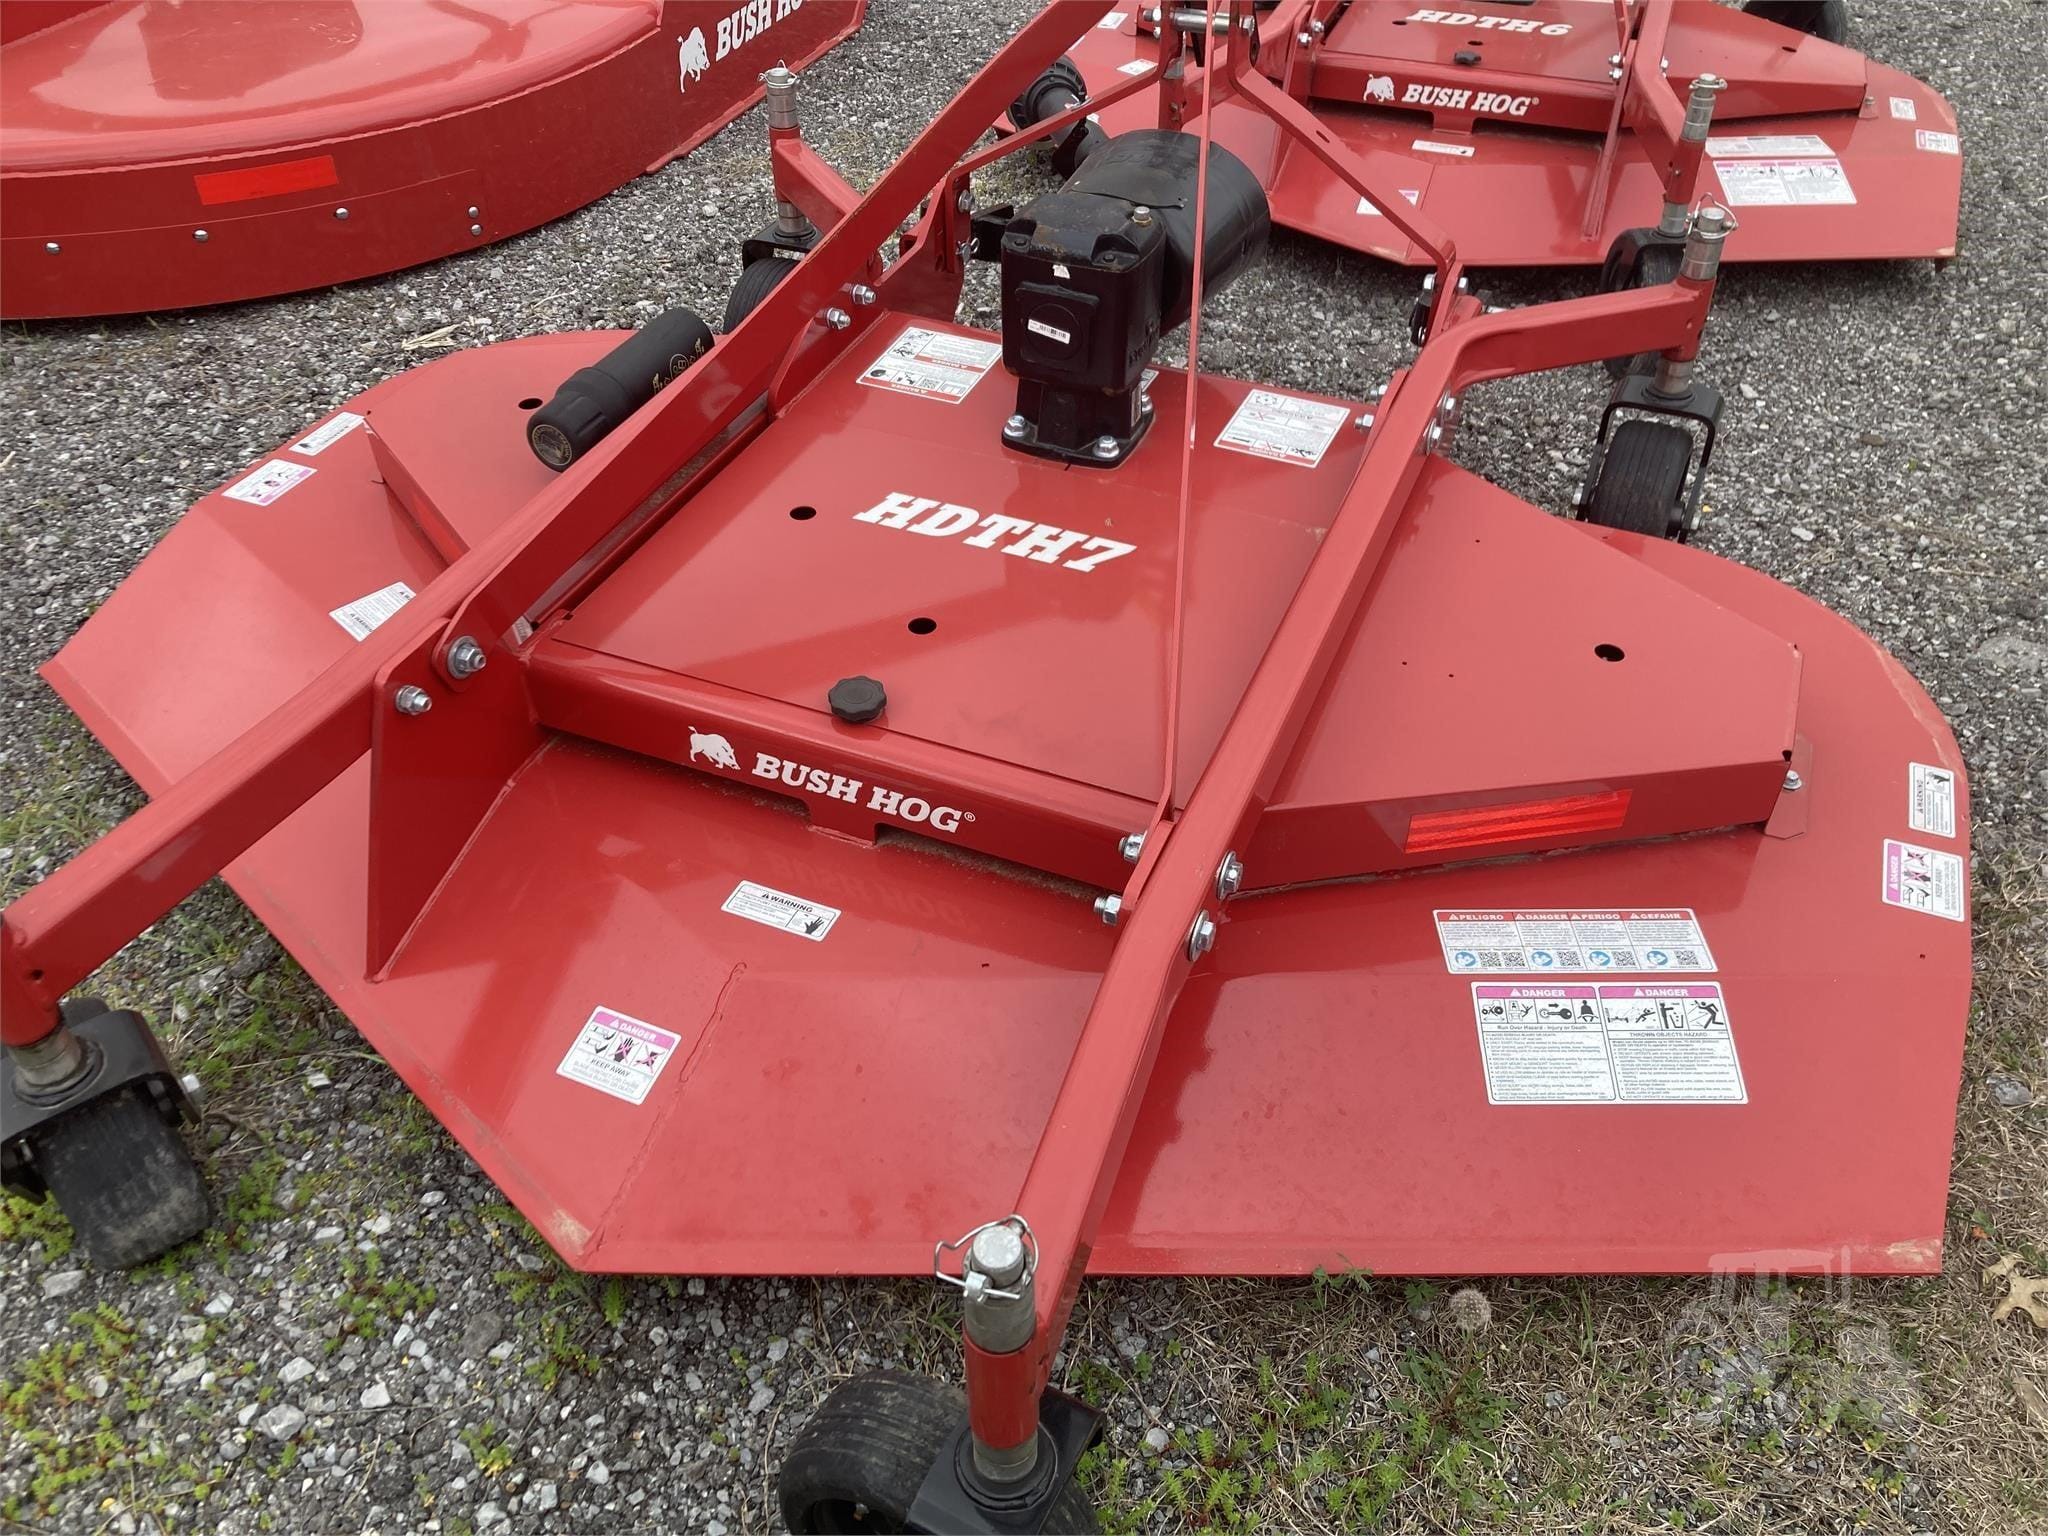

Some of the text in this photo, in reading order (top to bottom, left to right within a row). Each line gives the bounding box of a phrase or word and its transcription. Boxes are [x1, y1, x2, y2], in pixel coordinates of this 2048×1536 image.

[716, 0, 772, 62] BUSH
[1401, 84, 1472, 110] BUSH
[852, 492, 1137, 573] HDTH7
[751, 752, 863, 804] BUSH
[771, 895, 813, 913] WARNING
[1521, 989, 1565, 998] DANGER
[1645, 988, 1689, 997] DANGER
[620, 1023, 657, 1040] DANGER
[591, 1058, 630, 1077] KEEP AWAY
